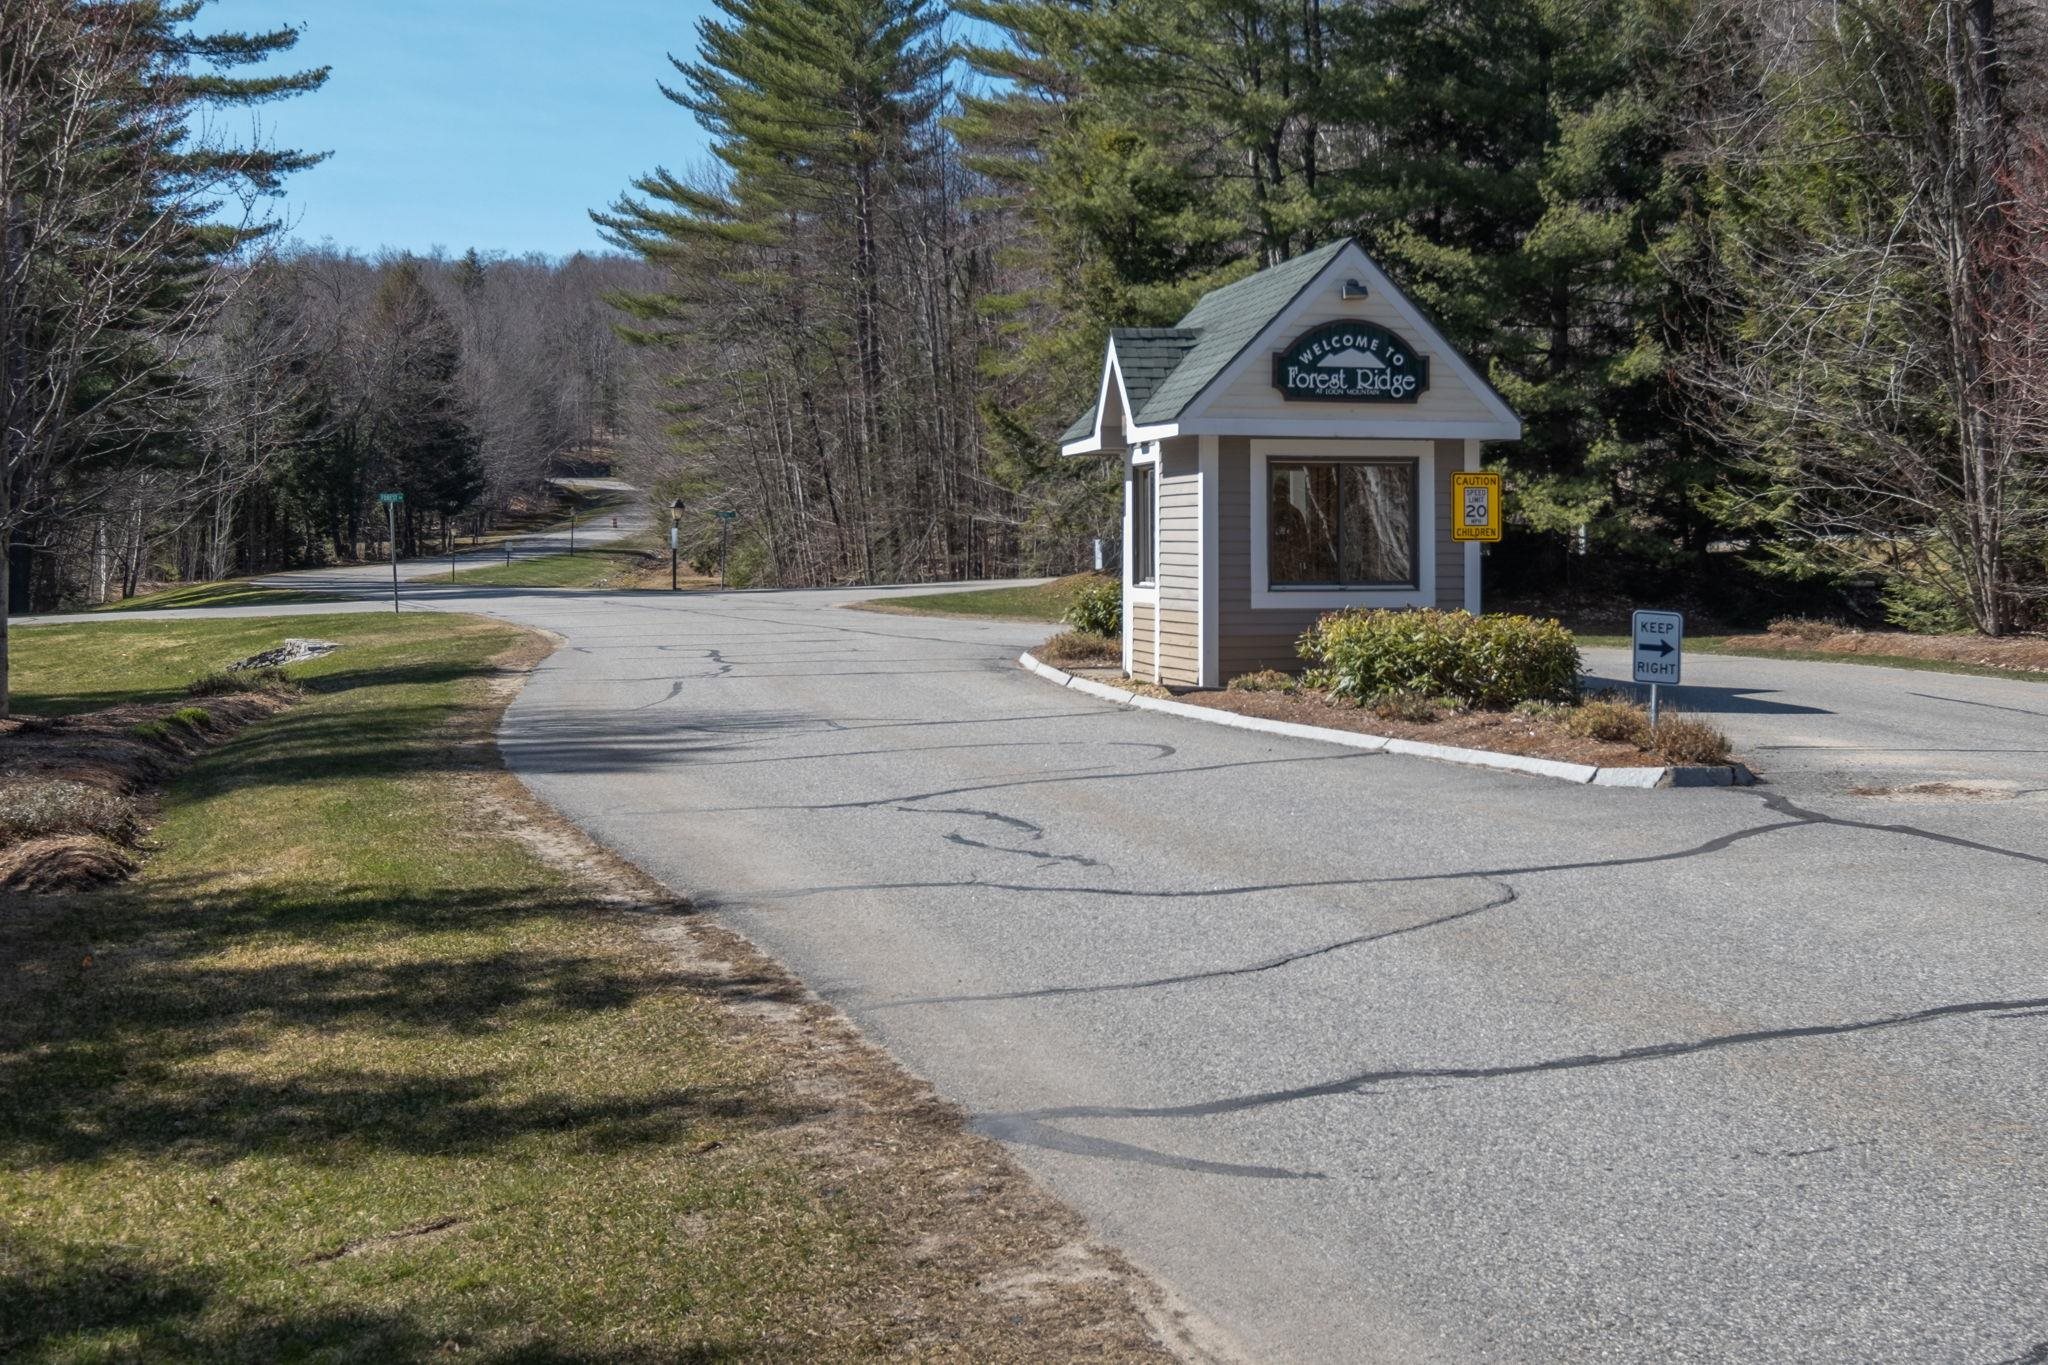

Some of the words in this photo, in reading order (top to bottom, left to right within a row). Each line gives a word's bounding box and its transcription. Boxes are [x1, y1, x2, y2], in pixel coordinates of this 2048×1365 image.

[1299, 335, 1379, 364] WELCOME
[1387, 346, 1404, 365] TO
[1288, 366, 1348, 389] Forest
[1357, 367, 1416, 398] Ridge
[1456, 476, 1497, 486] CAUTION
[1466, 504, 1487, 518] 20
[1456, 528, 1496, 537] CHILDREN
[1641, 622, 1674, 634] KEEP
[1637, 661, 1676, 675] RIGHT
